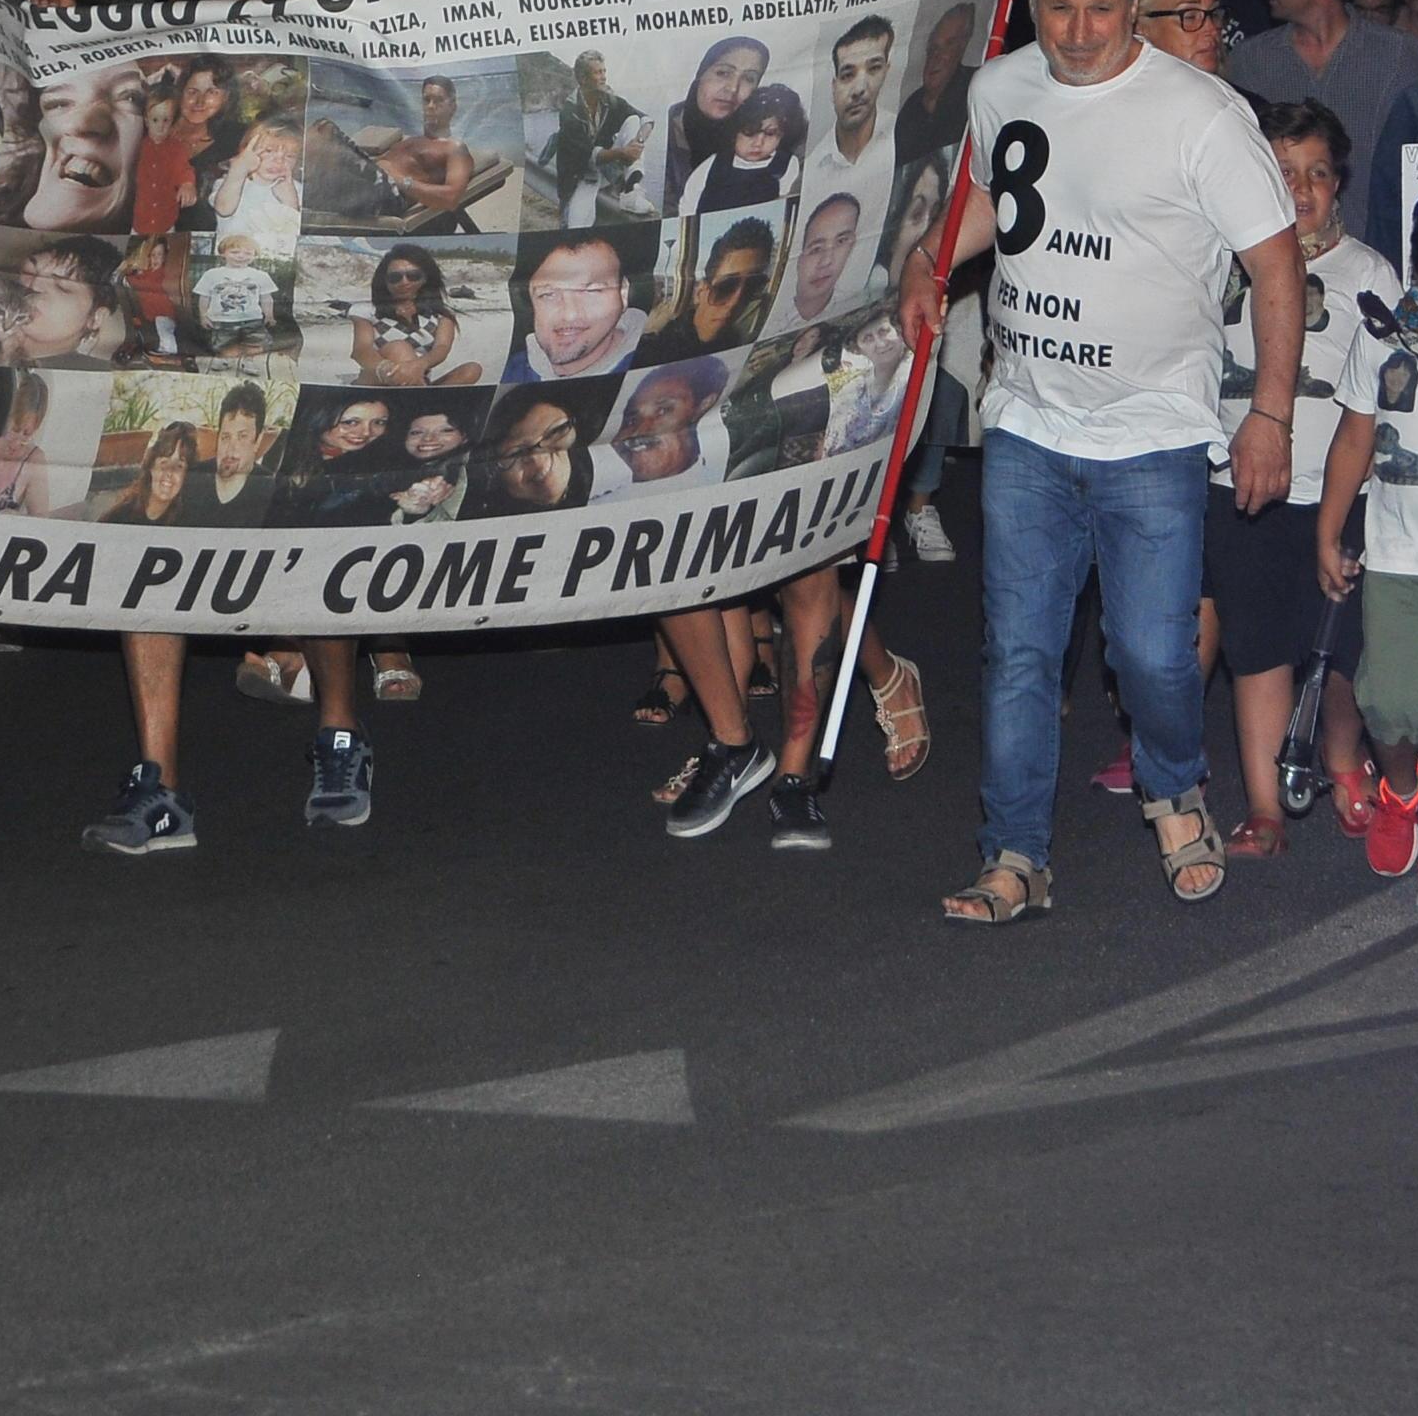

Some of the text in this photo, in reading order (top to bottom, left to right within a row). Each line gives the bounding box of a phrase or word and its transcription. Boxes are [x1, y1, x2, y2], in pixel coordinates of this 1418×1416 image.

[79, 39, 163, 65] ROBERTA,
[167, 27, 220, 46] MARIA
[226, 28, 282, 47] LUISA,
[288, 32, 355, 59] ANDREA,
[361, 41, 427, 59] ILARIA,
[435, 27, 522, 54] MICHELA,
[531, 16, 627, 43] ELISABETH,
[636, 6, 734, 32] MOHAMED,
[369, 12, 427, 36] AZIZA,
[442, 1, 502, 24] IMAN,
[990, 119, 1113, 261] 8 ANNI
[997, 278, 1081, 322] PER NON
[322, 534, 548, 615] COME
[561, 458, 884, 597] PRIMA!!!
